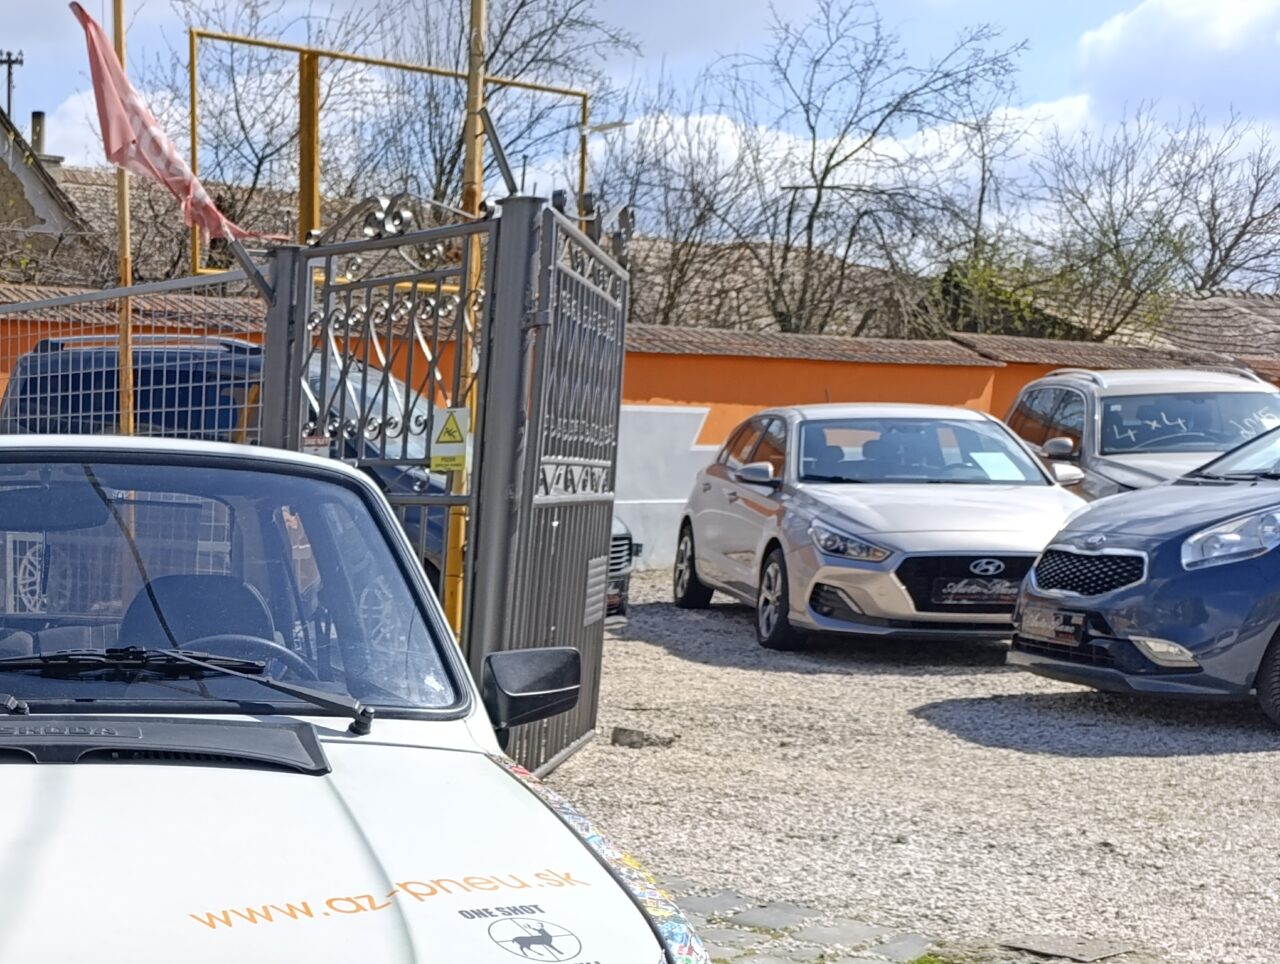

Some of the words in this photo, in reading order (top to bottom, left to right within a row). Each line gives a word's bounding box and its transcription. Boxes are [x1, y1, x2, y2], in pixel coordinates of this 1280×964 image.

[189, 868, 591, 930] www.az-pneu.sk
[457, 908, 498, 920] ONE
[494, 904, 546, 917] SHOT
